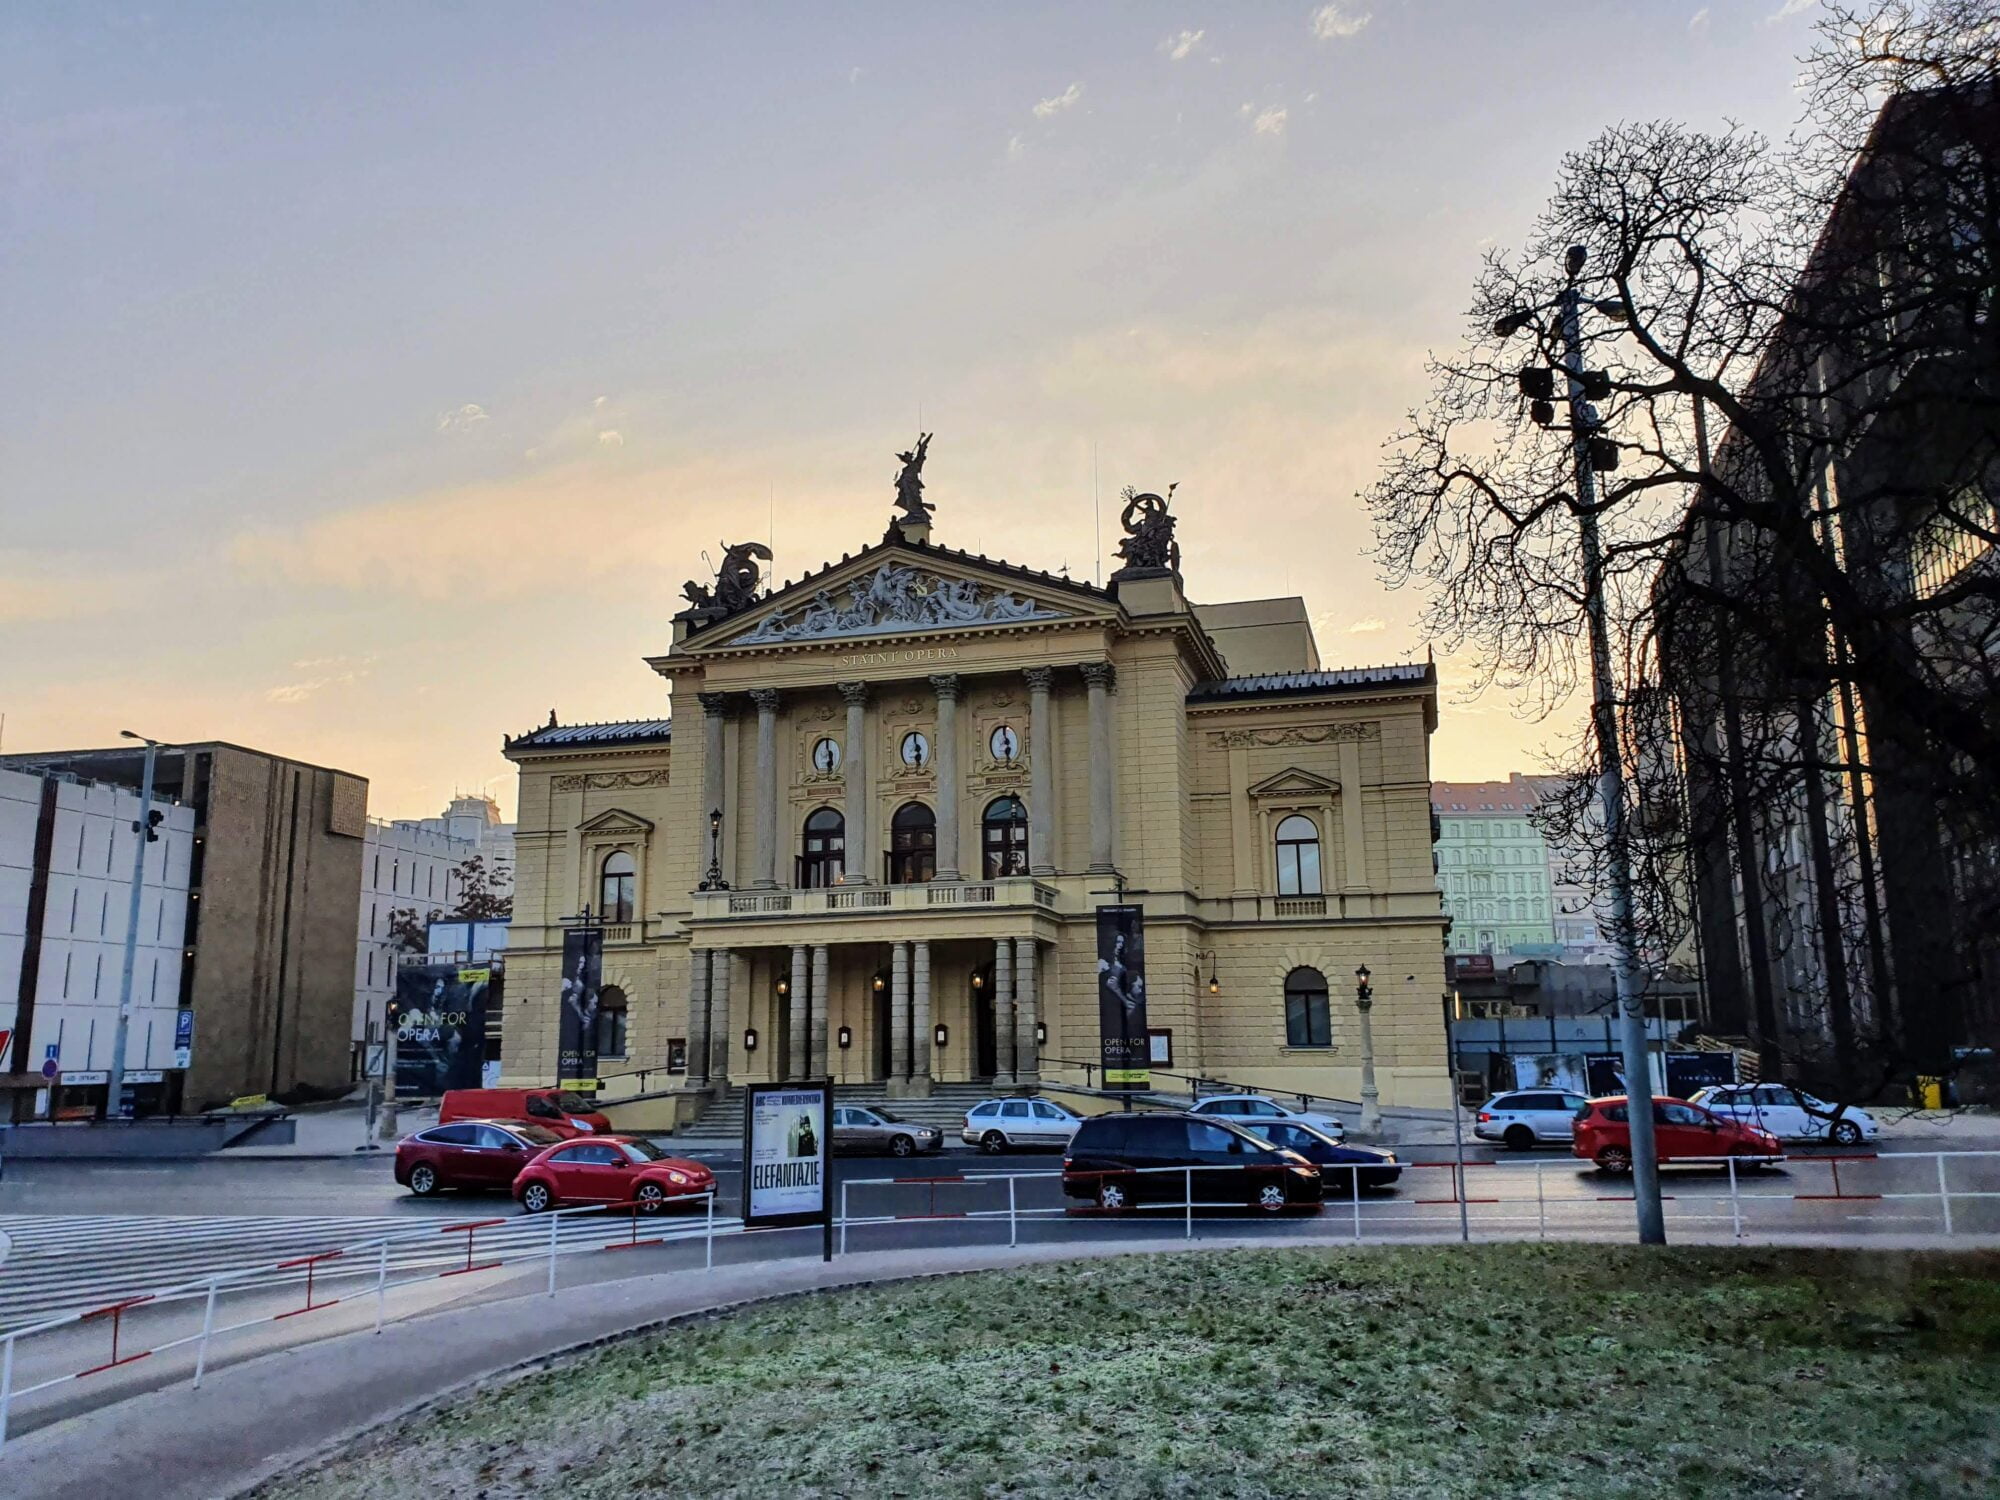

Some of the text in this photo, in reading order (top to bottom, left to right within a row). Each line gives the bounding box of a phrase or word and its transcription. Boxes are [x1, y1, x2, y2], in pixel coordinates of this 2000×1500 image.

[842, 648, 958, 666] STÁTNÍ OPERA
[440, 1012, 467, 1025] FOR
[397, 1028, 440, 1042] OPERA
[1104, 1038, 1145, 1046] OPEN FOR
[1104, 1046, 1131, 1054] OPERA
[753, 1161, 820, 1190] ELEFANTAZIE
